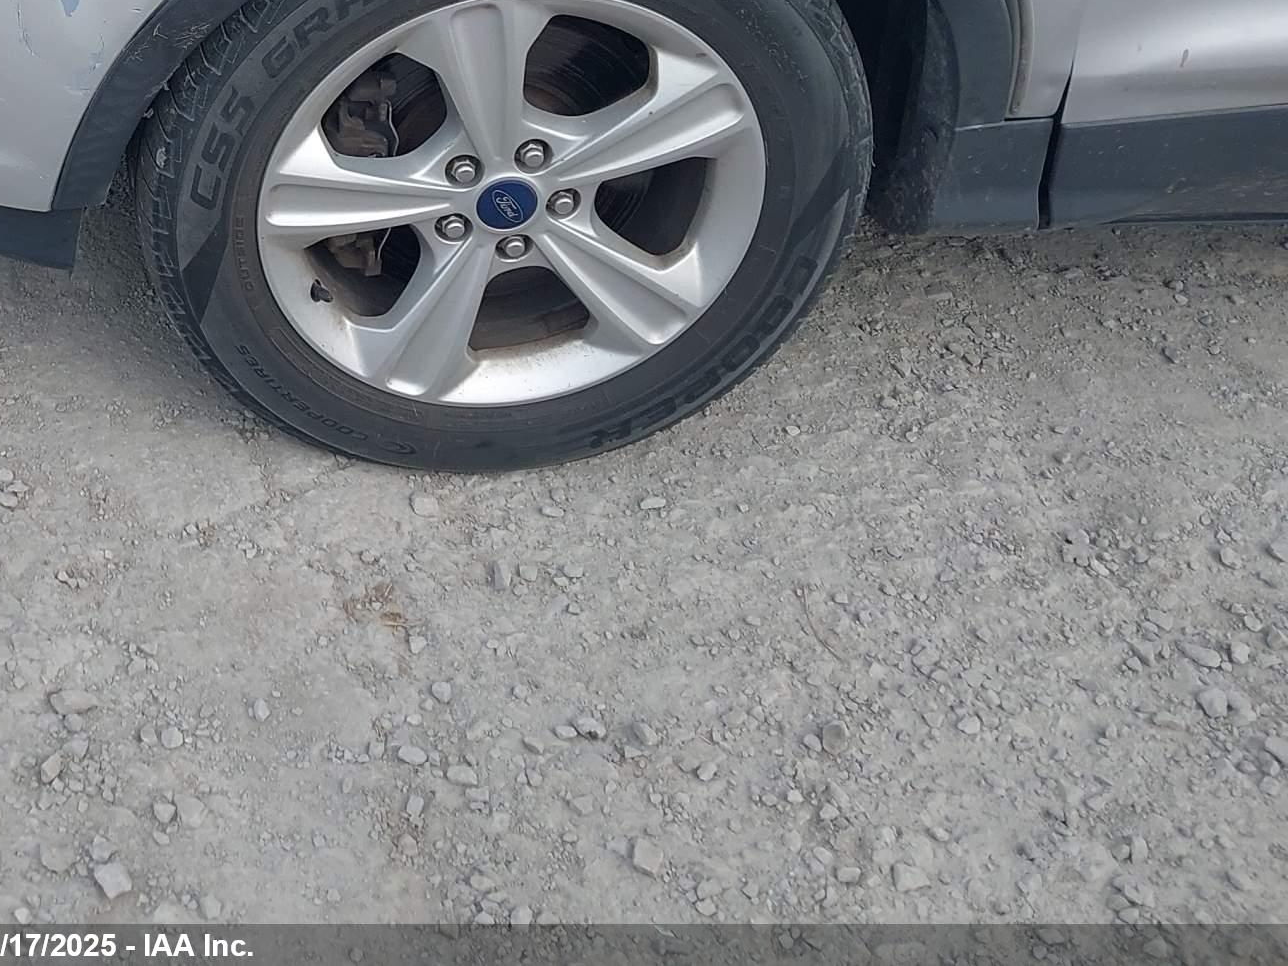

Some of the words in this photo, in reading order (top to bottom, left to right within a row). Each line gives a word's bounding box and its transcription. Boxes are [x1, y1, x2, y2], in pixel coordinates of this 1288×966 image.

[495, 196, 519, 218] Ford
[234, 210, 254, 293] OUTSIDE
[589, 255, 818, 449] COOPER
